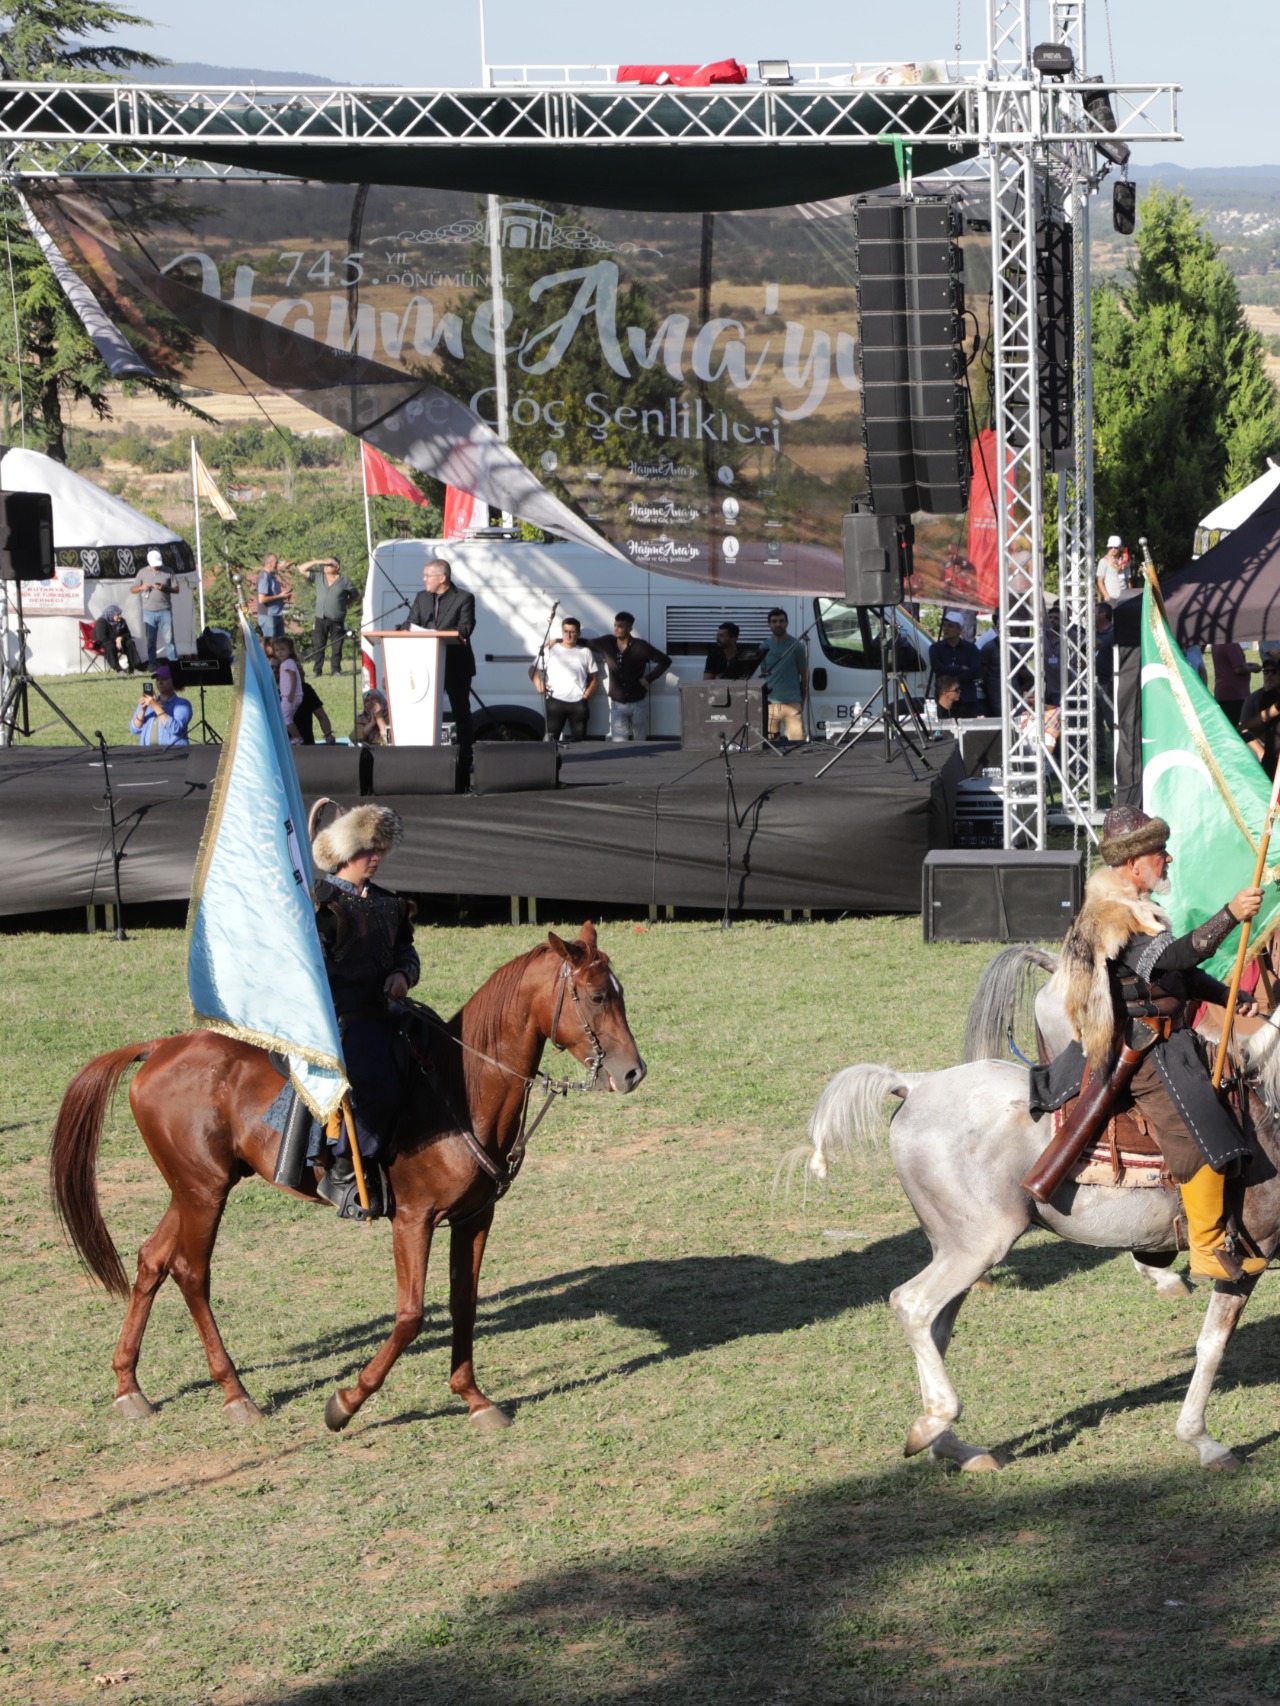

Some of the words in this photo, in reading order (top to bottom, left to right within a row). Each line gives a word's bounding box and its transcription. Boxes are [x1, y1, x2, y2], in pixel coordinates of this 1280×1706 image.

[278, 250, 380, 288] 745.
[386, 251, 411, 265] YIL
[386, 270, 516, 288] DÖNÜMÜNE
[585, 392, 780, 452] Şenlikleri
